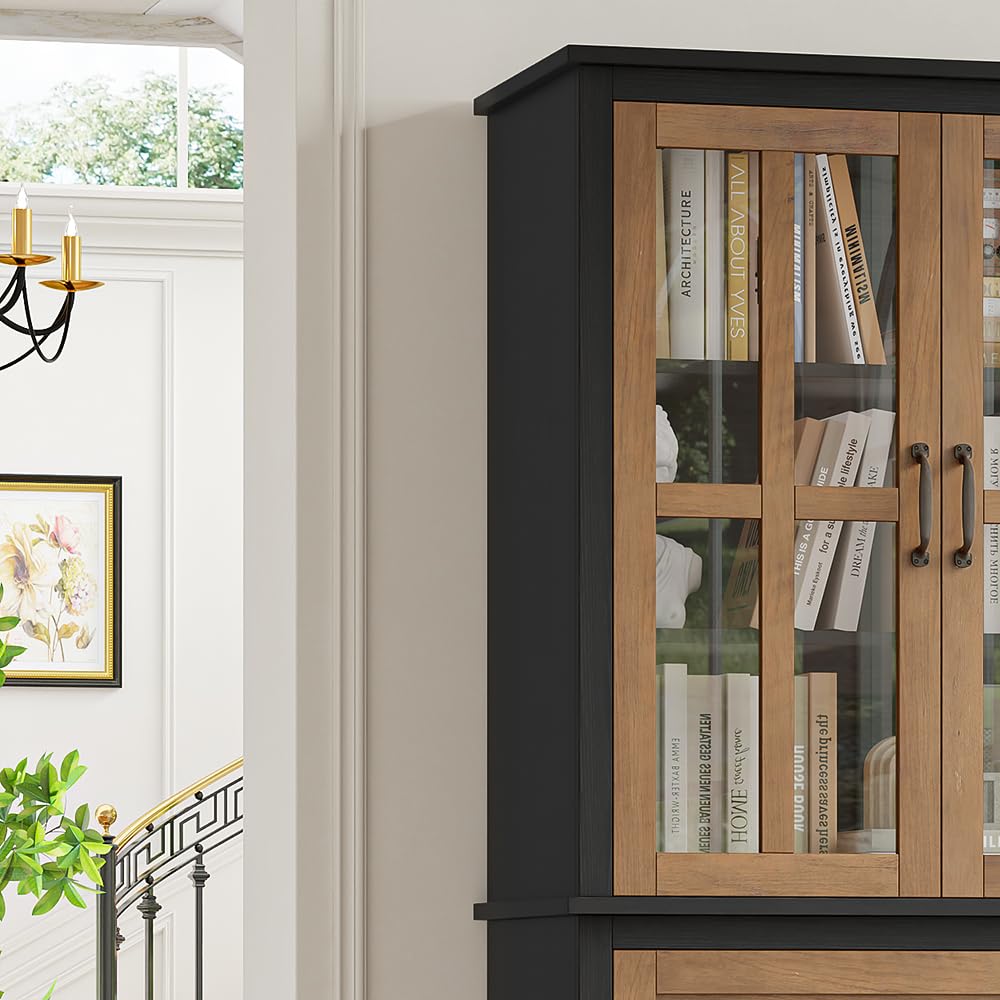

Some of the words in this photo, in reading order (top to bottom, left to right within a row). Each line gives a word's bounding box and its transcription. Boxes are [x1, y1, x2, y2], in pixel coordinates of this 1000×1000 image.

[730, 163, 745, 201] ALL
[681, 190, 692, 298] ARCHITECTURE
[730, 208, 745, 280] ABOUT
[730, 289, 745, 339] YVES
[819, 539, 830, 554] for
[840, 437, 858, 475] lifestyle
[990, 457, 999, 487] МОГУ
[850, 538, 866, 578] DREAM
[990, 559, 999, 604] МНОГОЕ
